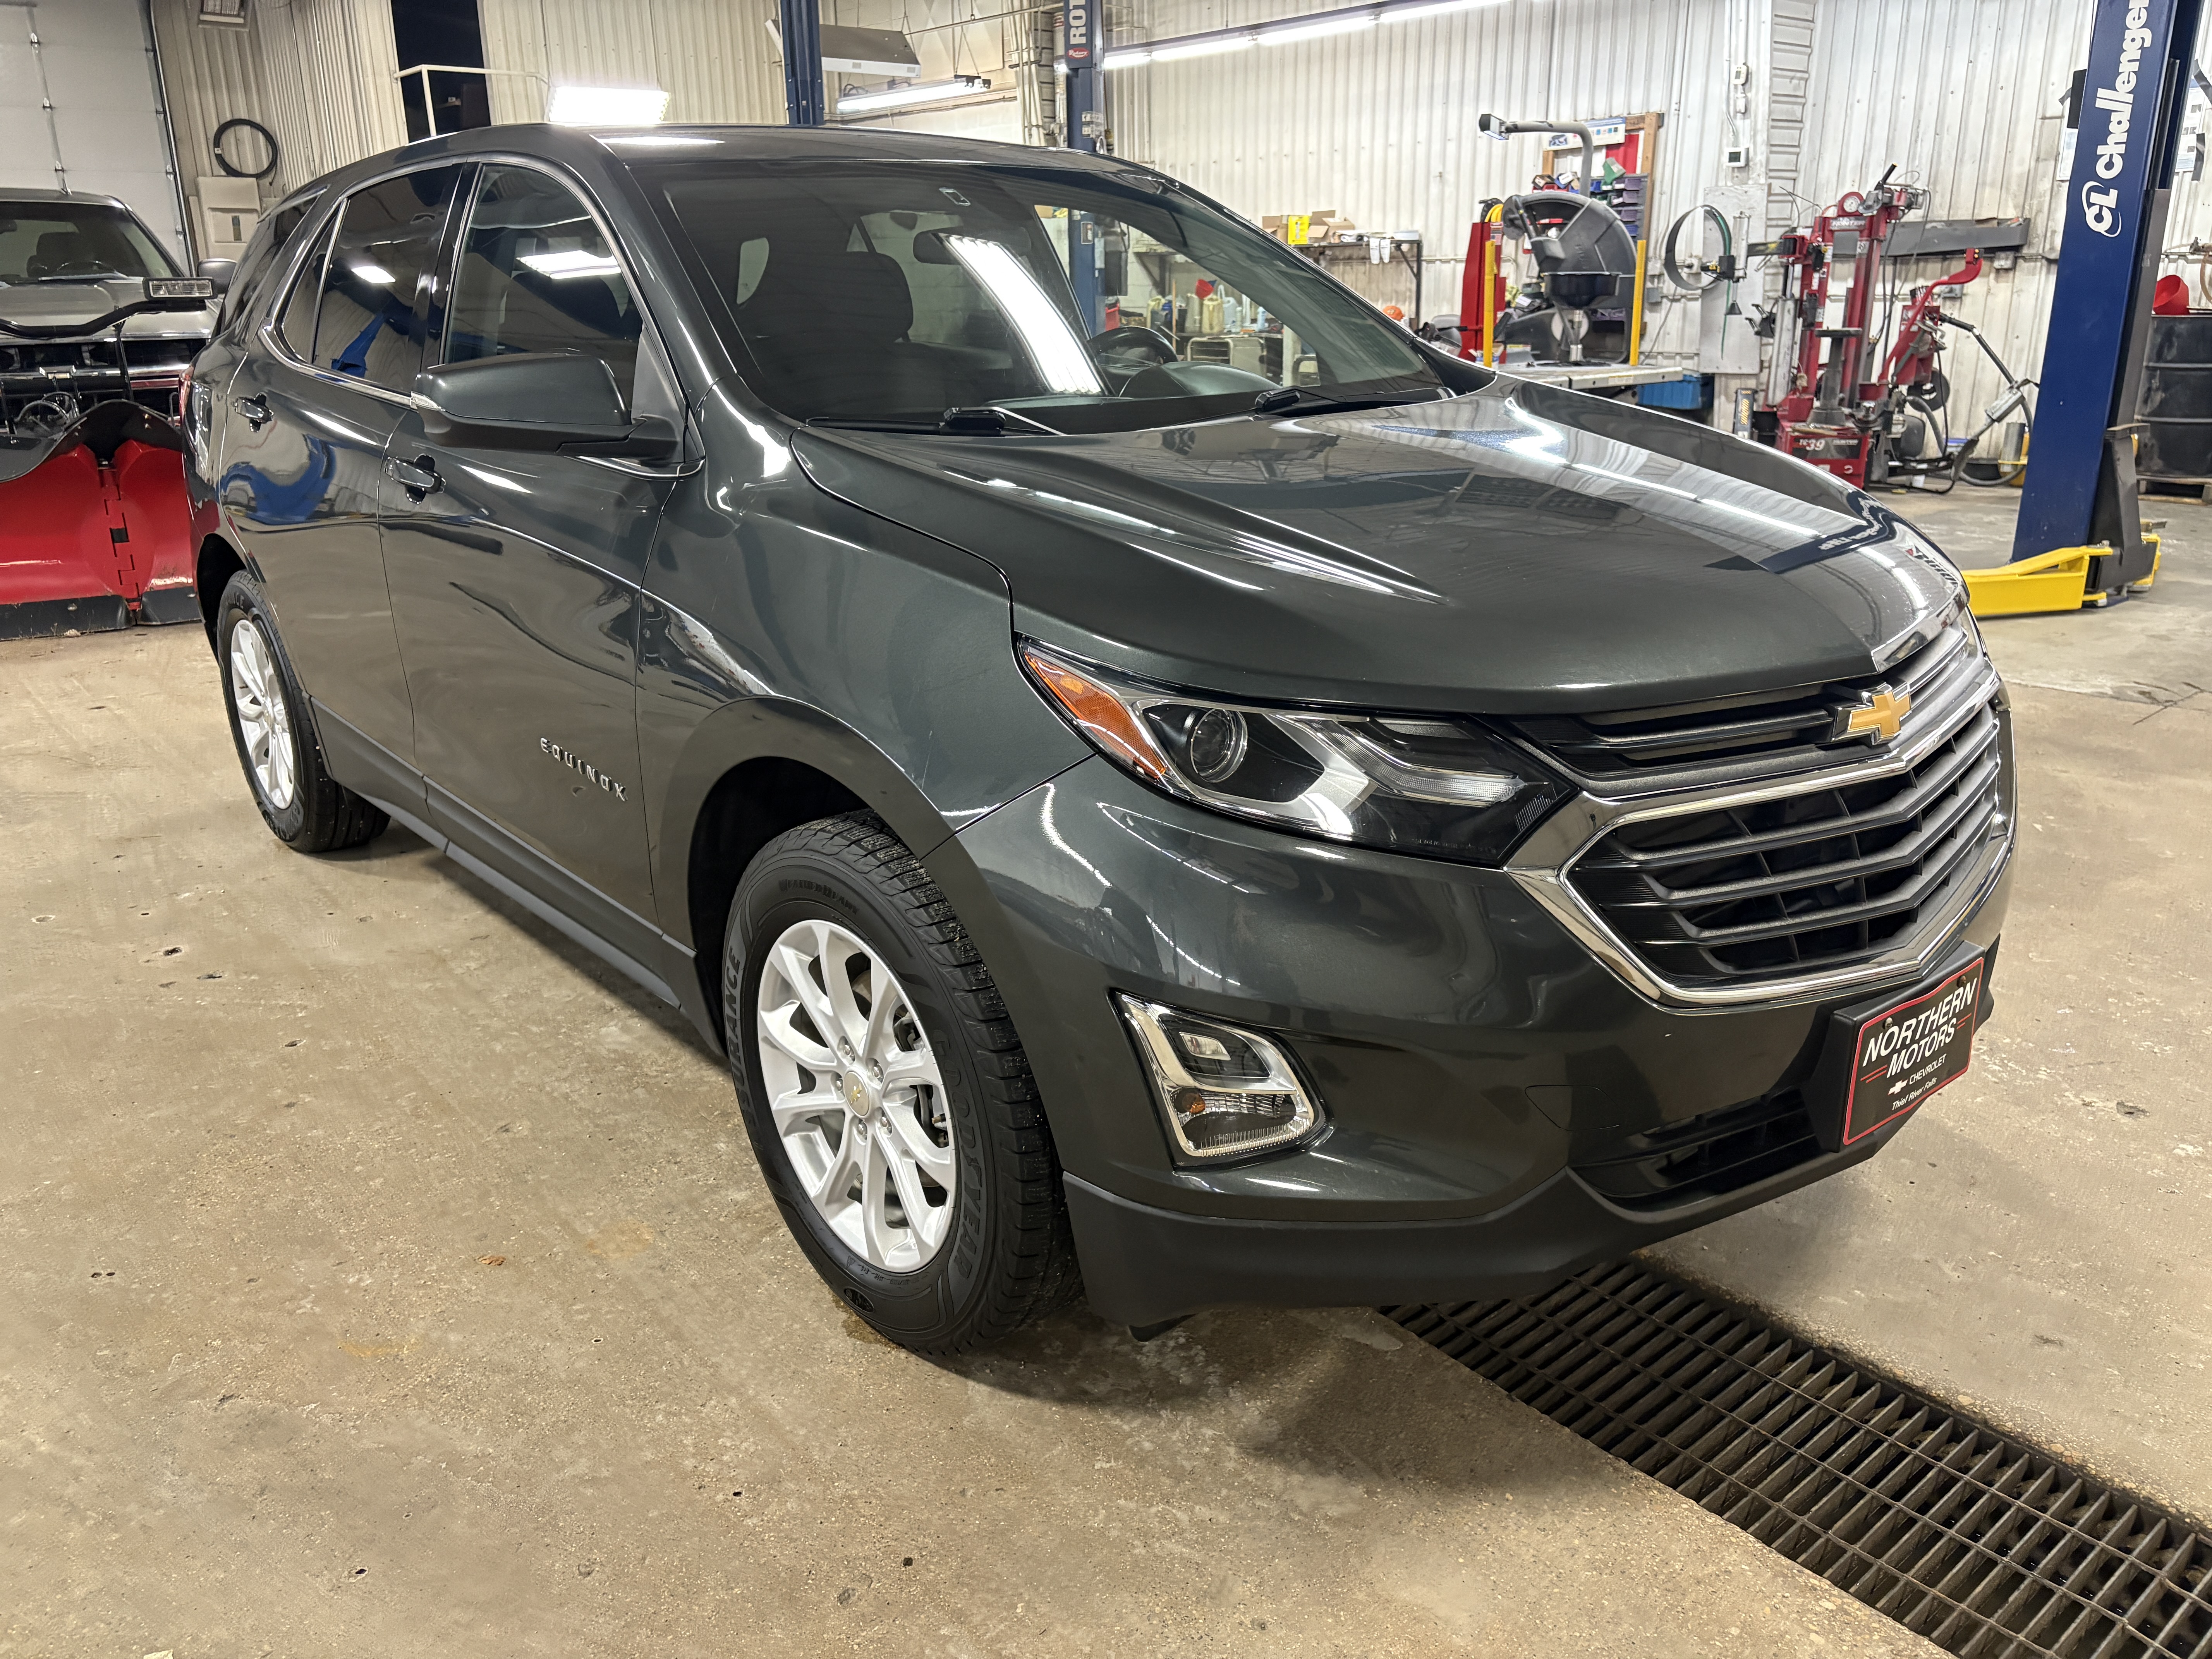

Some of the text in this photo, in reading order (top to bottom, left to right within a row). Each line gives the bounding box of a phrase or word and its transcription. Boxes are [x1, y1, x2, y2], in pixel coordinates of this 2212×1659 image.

[540, 737, 628, 802] EQUINOX
[725, 946, 757, 1135] SSURANCE
[1862, 977, 1977, 1067] NORTHERN
[1887, 1017, 1956, 1078] MOTORS
[1892, 1077, 1937, 1111] Thief River Falls
[1909, 1053, 1947, 1085] CHEVROLET
